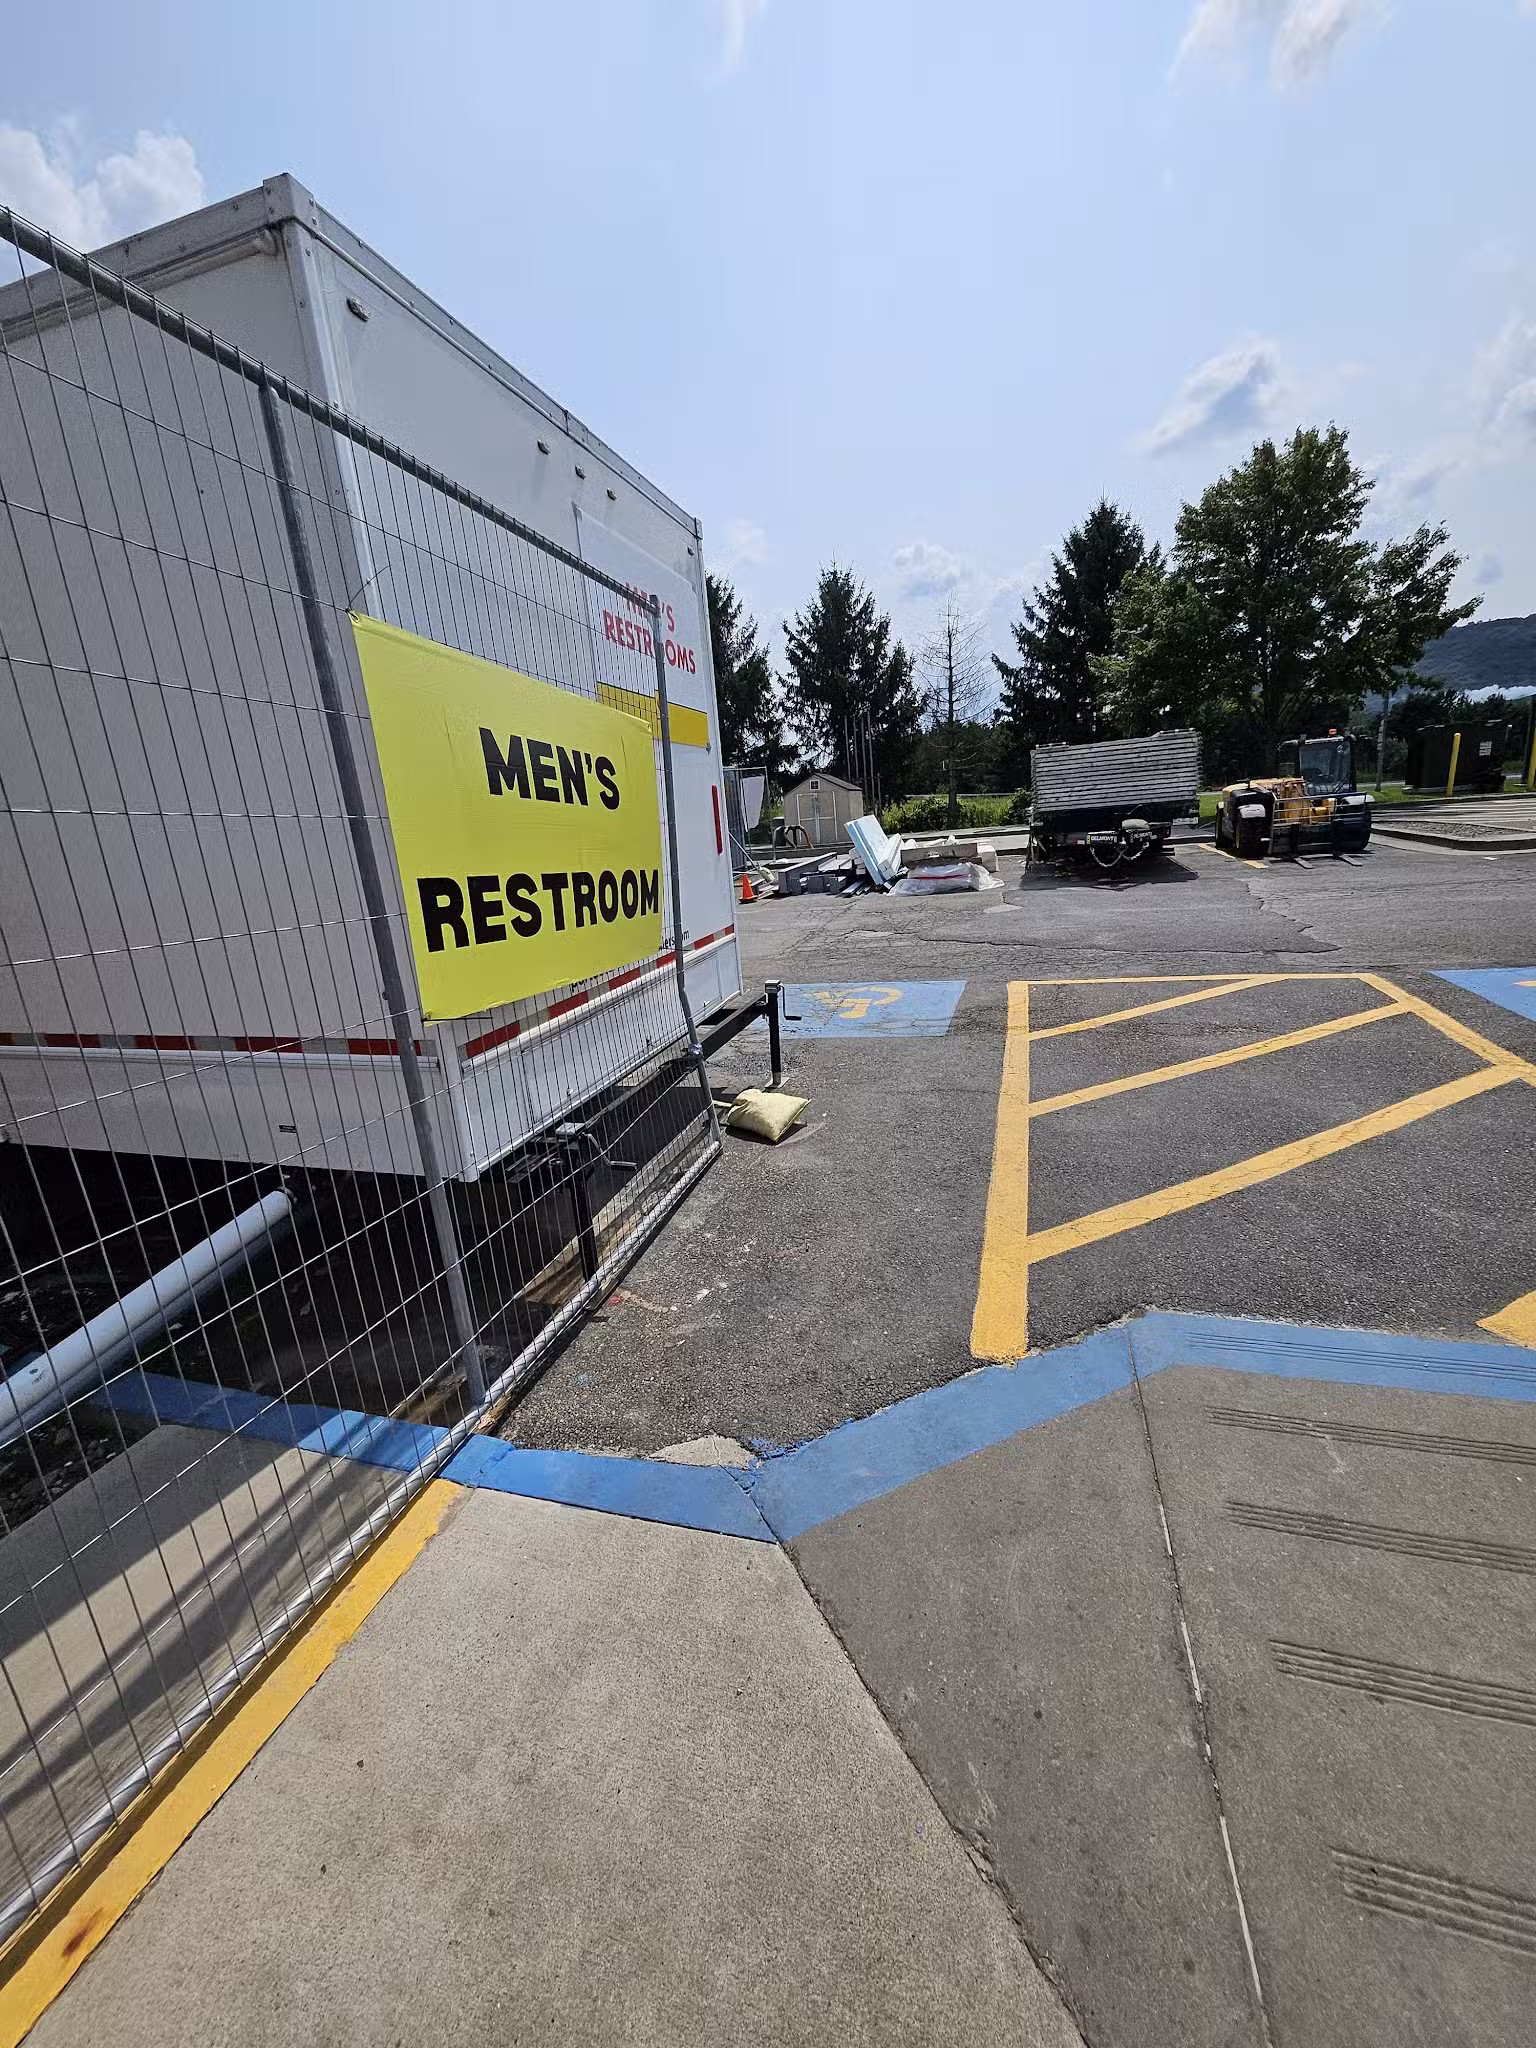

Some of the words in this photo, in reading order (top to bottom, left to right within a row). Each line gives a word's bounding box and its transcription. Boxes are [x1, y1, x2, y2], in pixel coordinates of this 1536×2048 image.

[603, 608, 696, 674] RESTROMS
[479, 727, 620, 810] MEN'S
[417, 869, 659, 953] RESTROOM
